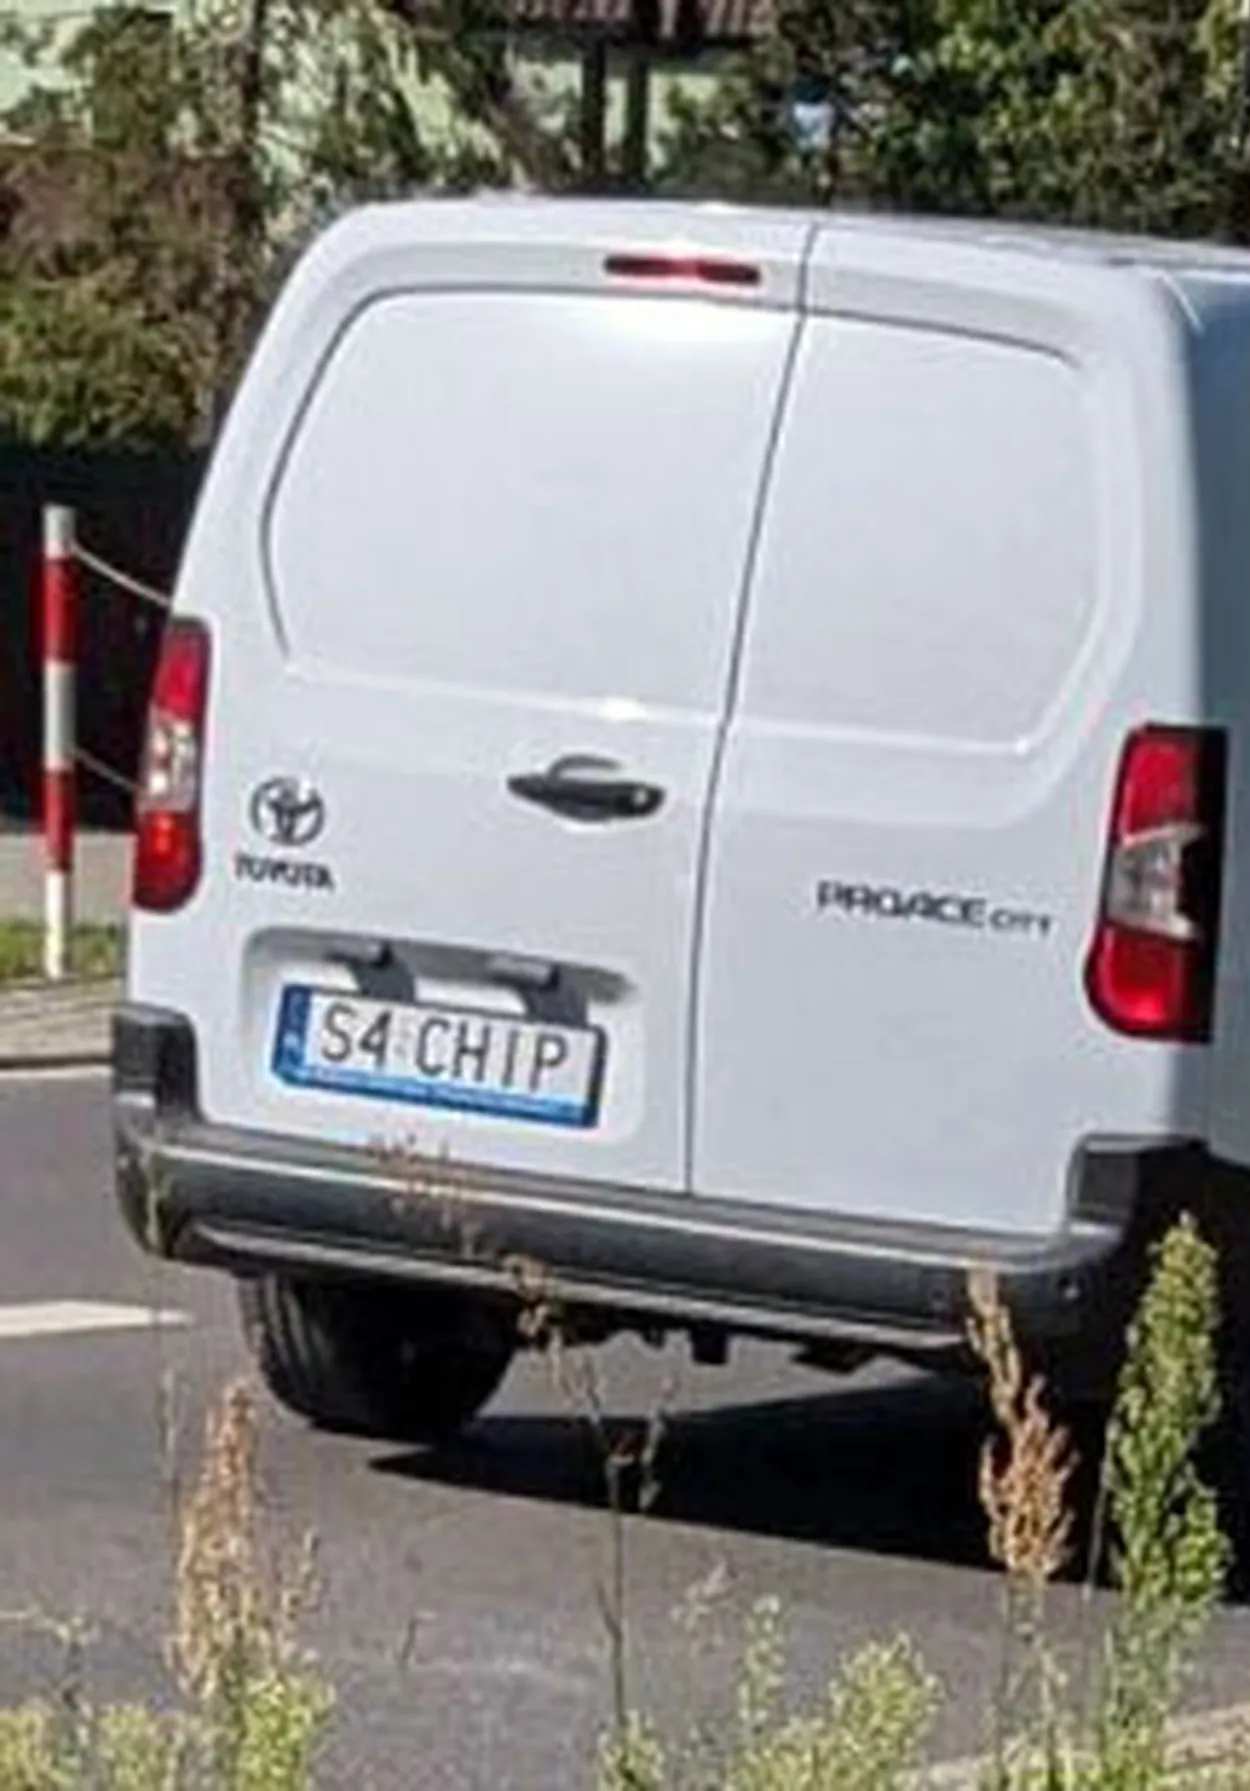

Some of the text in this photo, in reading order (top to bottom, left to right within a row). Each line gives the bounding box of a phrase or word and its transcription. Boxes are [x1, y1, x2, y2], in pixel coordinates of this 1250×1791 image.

[233, 852, 336, 892] TOYOTA
[816, 879, 988, 929] PROACE
[320, 1000, 392, 1074] S4
[414, 1016, 569, 1092] CHIP
